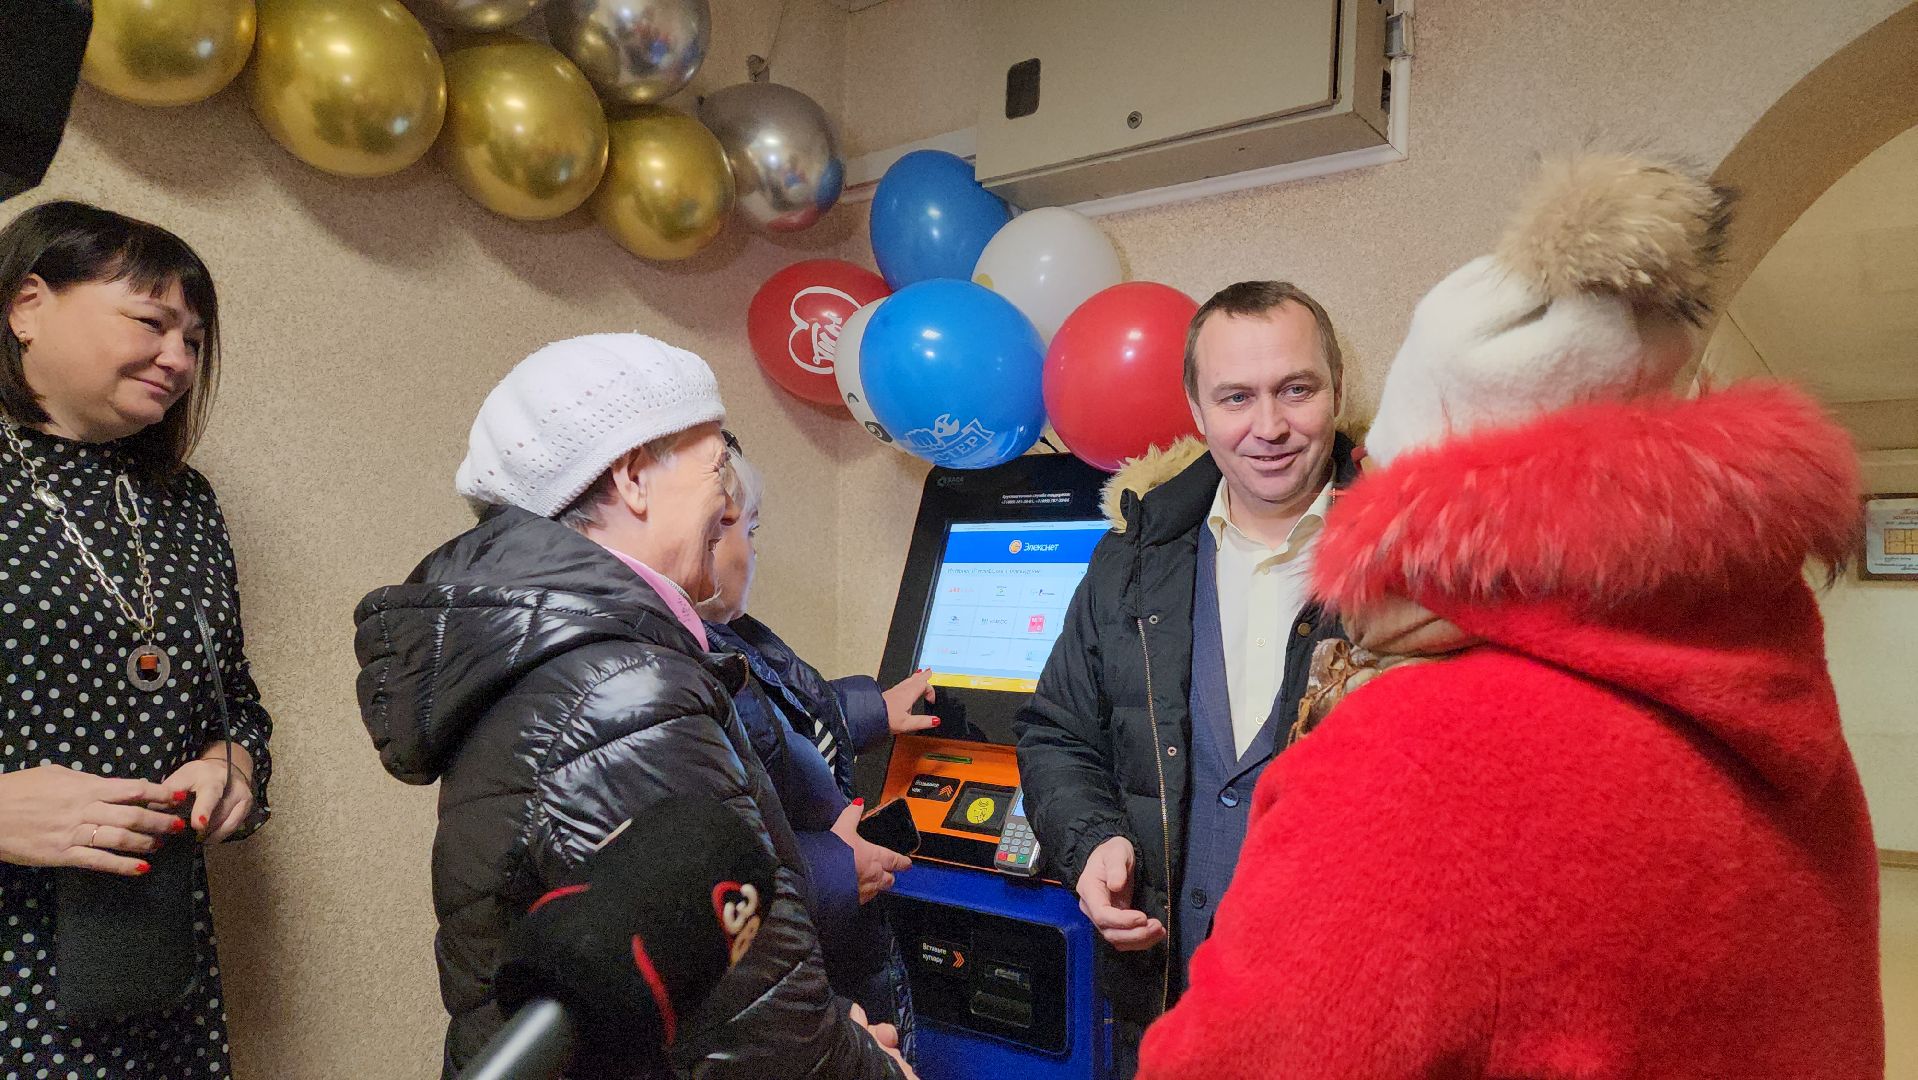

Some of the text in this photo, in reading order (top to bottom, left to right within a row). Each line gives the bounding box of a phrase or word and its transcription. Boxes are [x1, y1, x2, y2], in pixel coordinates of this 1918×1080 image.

[1023, 542, 1060, 552] Элекснет
[922, 942, 947, 955] Вставьте
[922, 953, 944, 965] купюру
